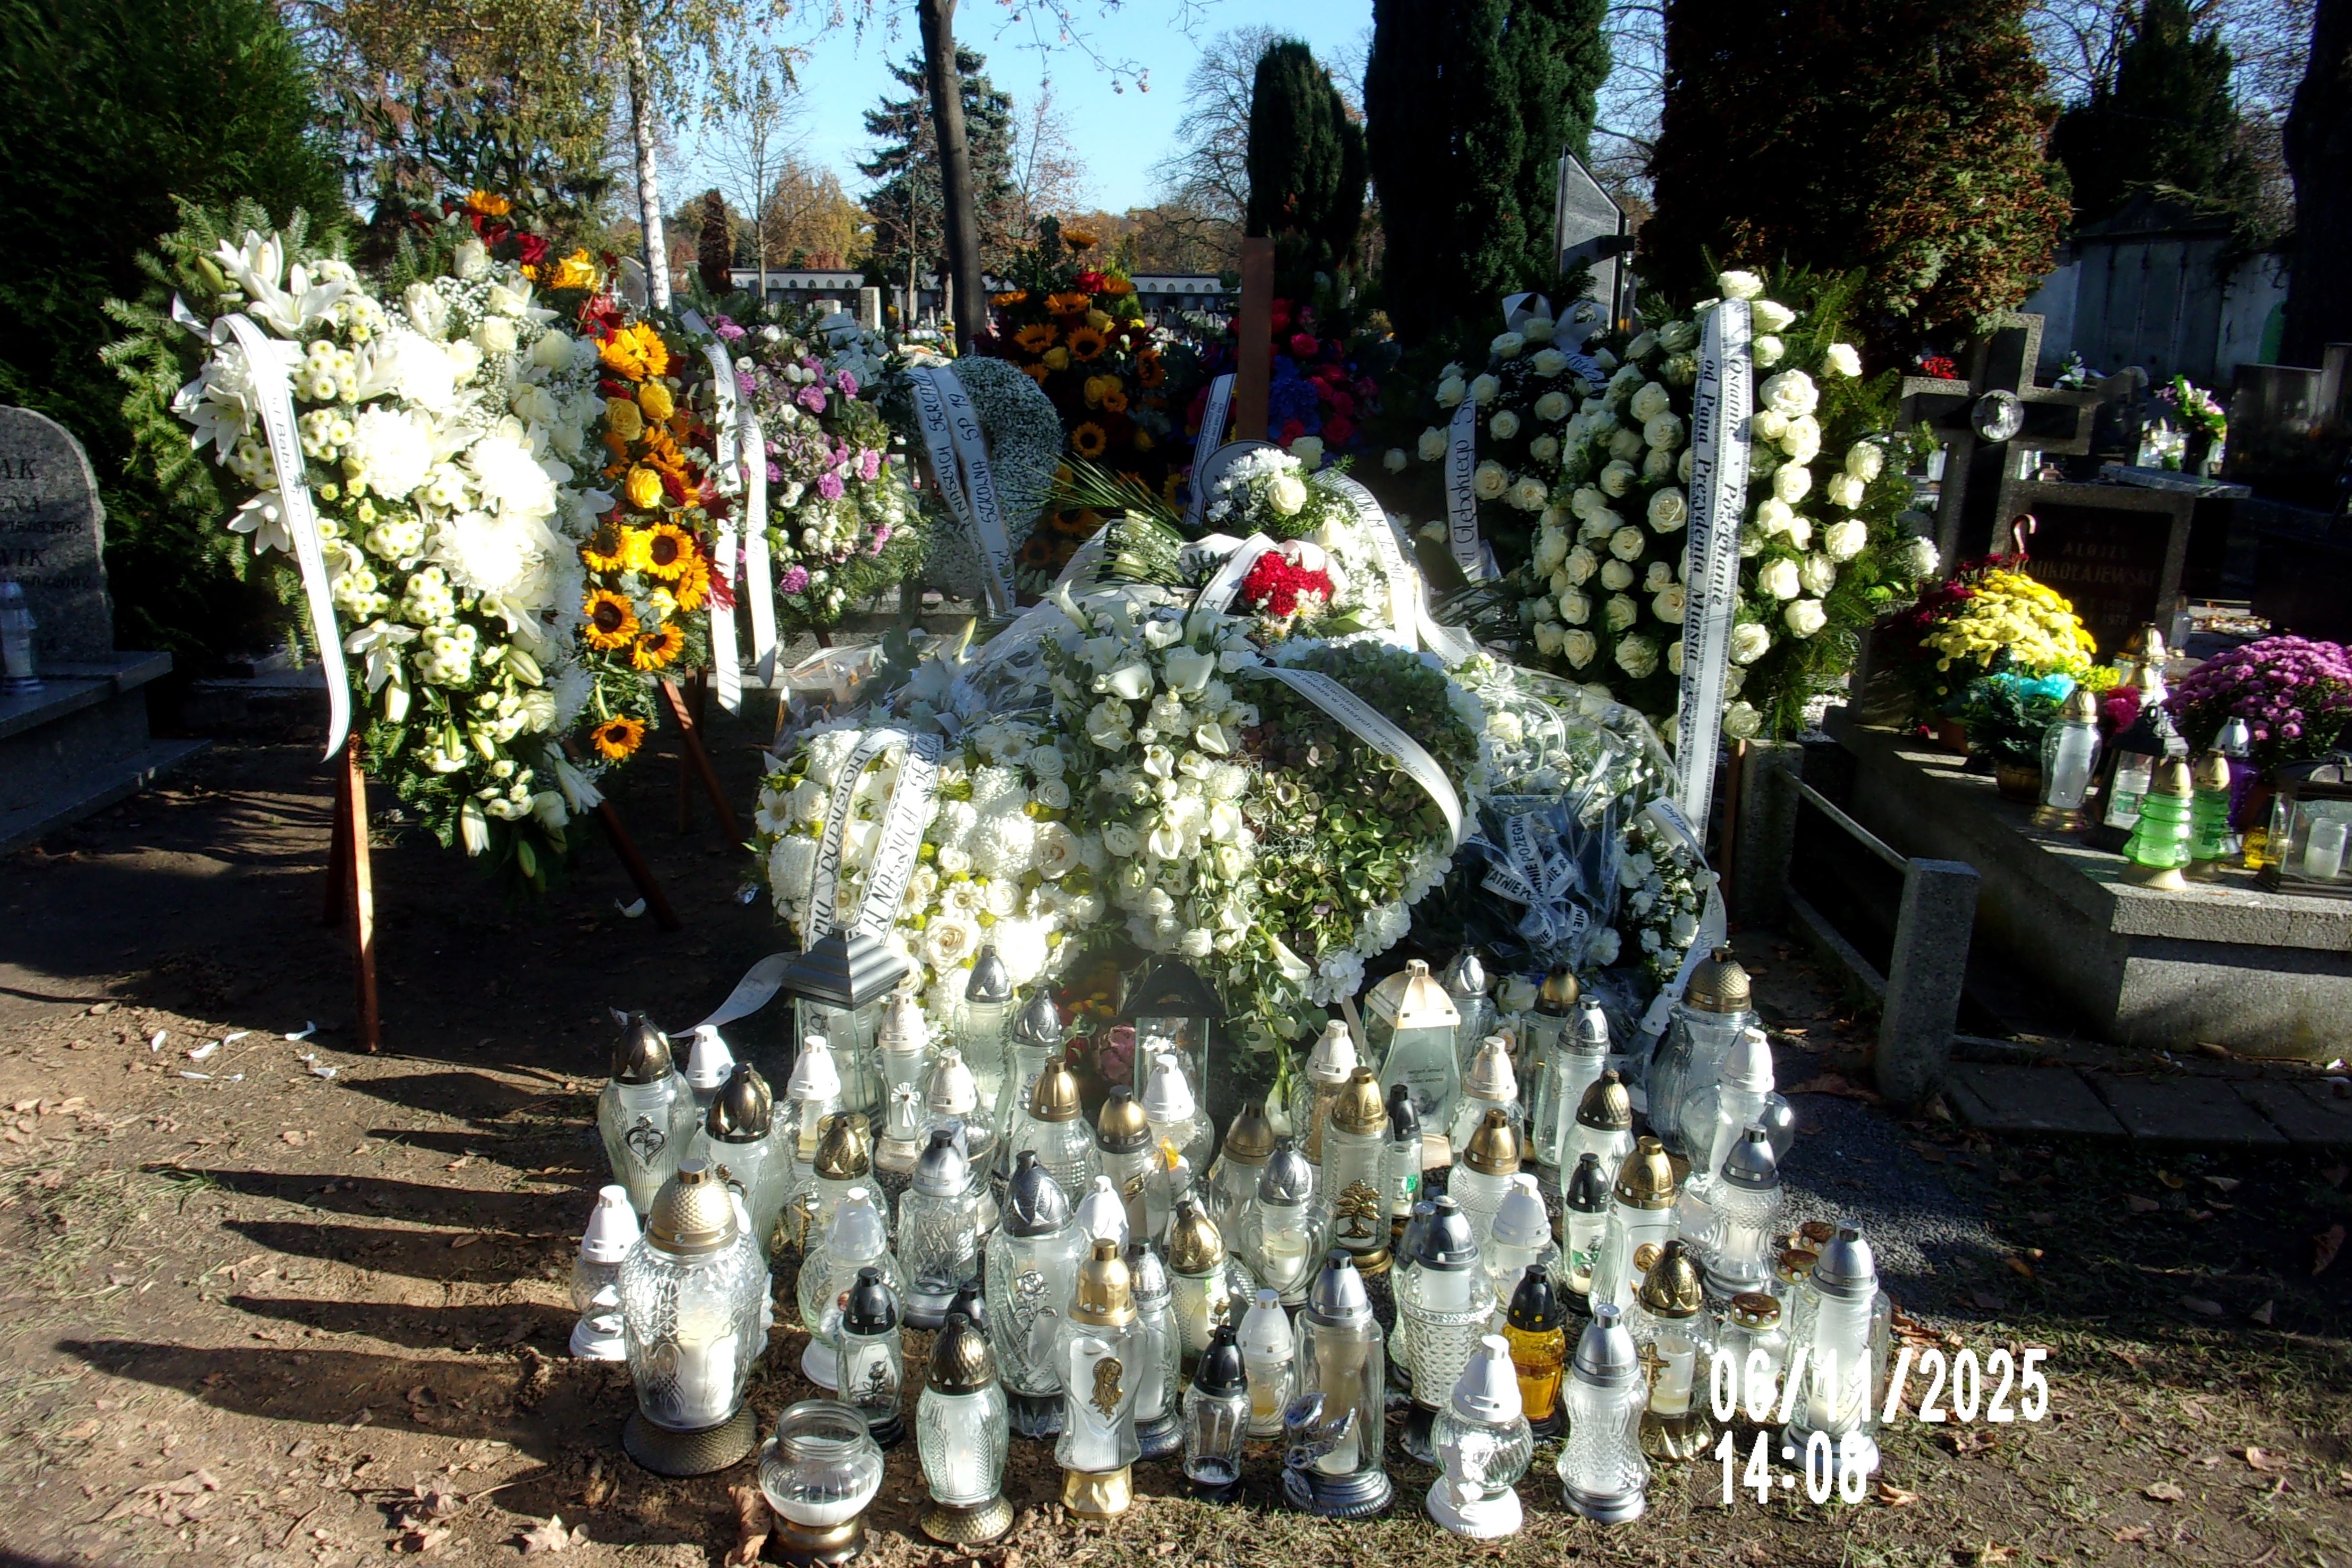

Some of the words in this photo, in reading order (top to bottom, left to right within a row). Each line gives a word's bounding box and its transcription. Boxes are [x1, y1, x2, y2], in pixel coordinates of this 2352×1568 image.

[1704, 360, 1718, 383] od
[948, 393, 969, 408] 19
[1698, 394, 1715, 443] Pana
[956, 417, 979, 441] SP
[937, 445, 967, 512] NASZYCH
[971, 460, 999, 523] SZKOLNA
[1693, 458, 1712, 574] Prezydenta
[1301, 675, 1330, 697] zawsze
[1339, 702, 1372, 729] naszych
[1373, 728, 1405, 753] sercach
[1379, 741, 1405, 761] Mama
